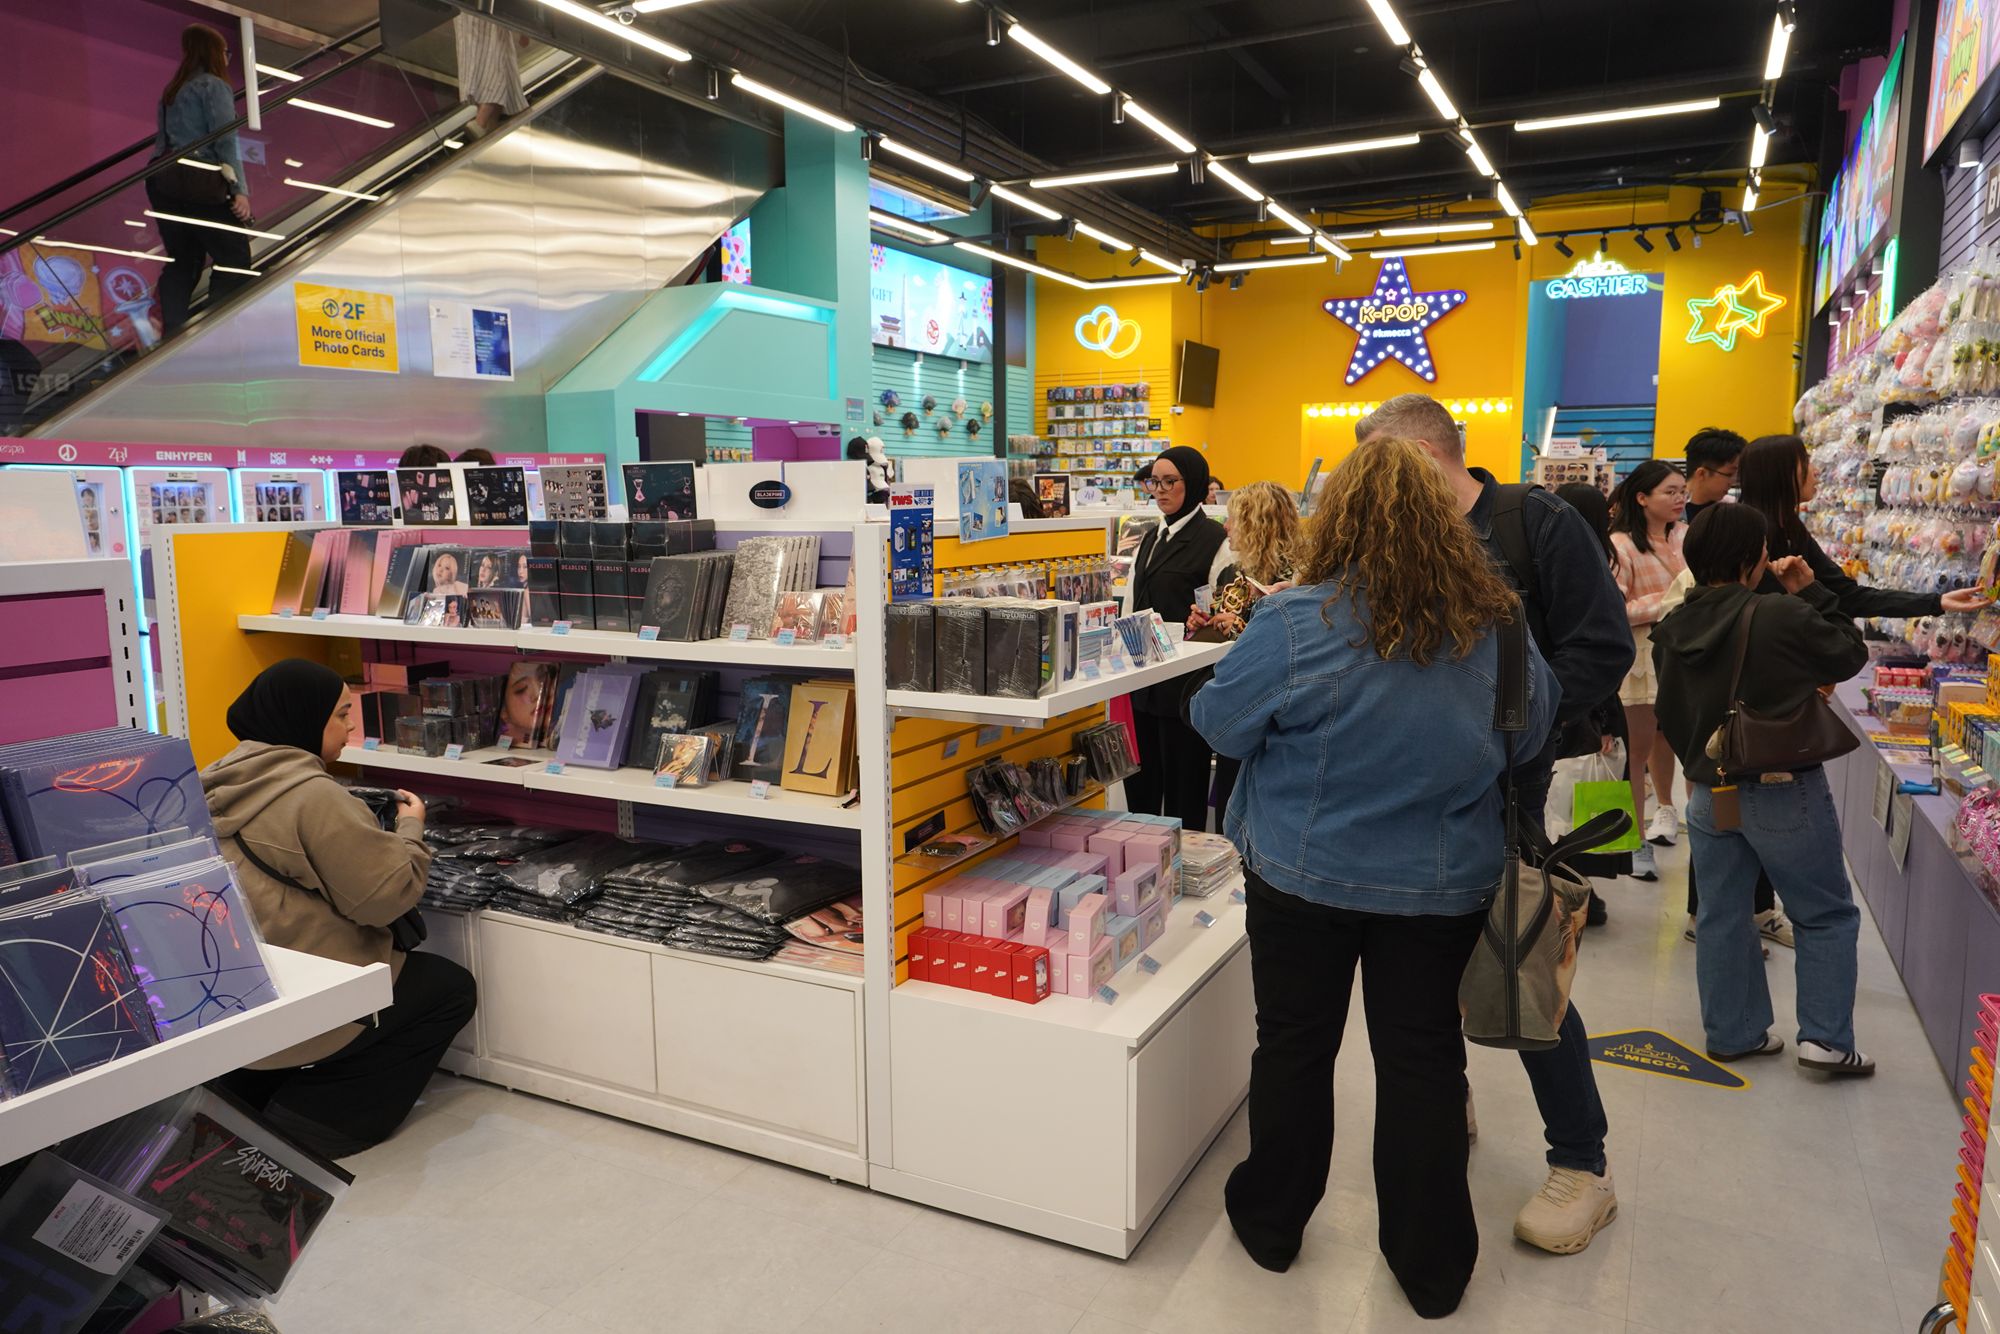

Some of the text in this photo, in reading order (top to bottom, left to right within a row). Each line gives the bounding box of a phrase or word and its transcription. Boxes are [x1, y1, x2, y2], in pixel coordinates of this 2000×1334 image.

[871, 286, 894, 303] GIFT
[1545, 274, 1649, 300] CASHIER
[342, 301, 366, 321] 2F
[1360, 302, 1429, 325] K-POP
[311, 325, 386, 345] More Official
[1372, 328, 1412, 338] #kmecca
[314, 340, 386, 359] Photo Cards
[155, 451, 213, 462] ENHYPEN
[891, 495, 913, 506] TWS
[1603, 1049, 1691, 1072] K-MECCA
